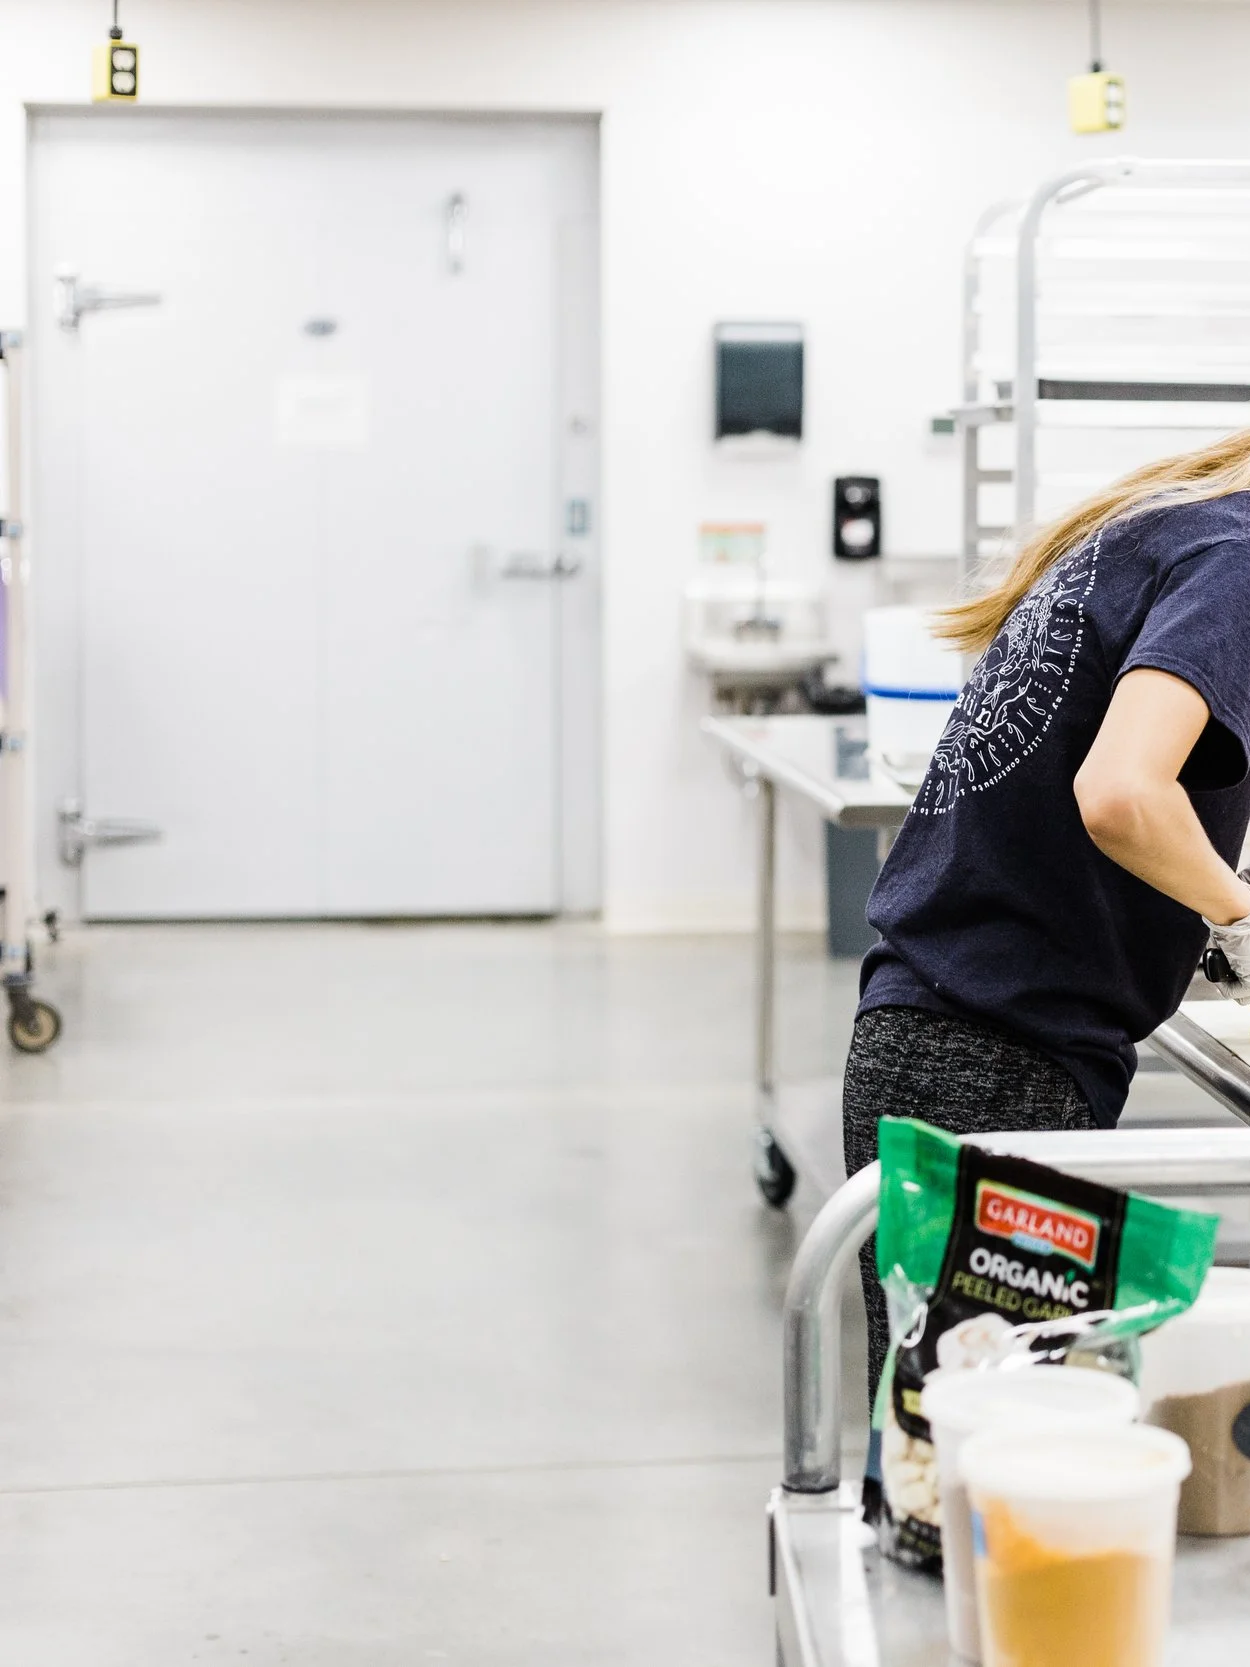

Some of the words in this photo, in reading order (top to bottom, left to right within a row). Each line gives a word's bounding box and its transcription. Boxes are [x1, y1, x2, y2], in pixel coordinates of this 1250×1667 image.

[1067, 629, 1084, 673] actions
[1061, 679, 1071, 692] of
[1052, 695, 1063, 711] my
[1041, 714, 1053, 732] own
[1022, 735, 1043, 756] life
[971, 757, 1020, 792] contribute
[986, 1197, 1089, 1250] GARLAND
[951, 1269, 1022, 1313] PEELED
